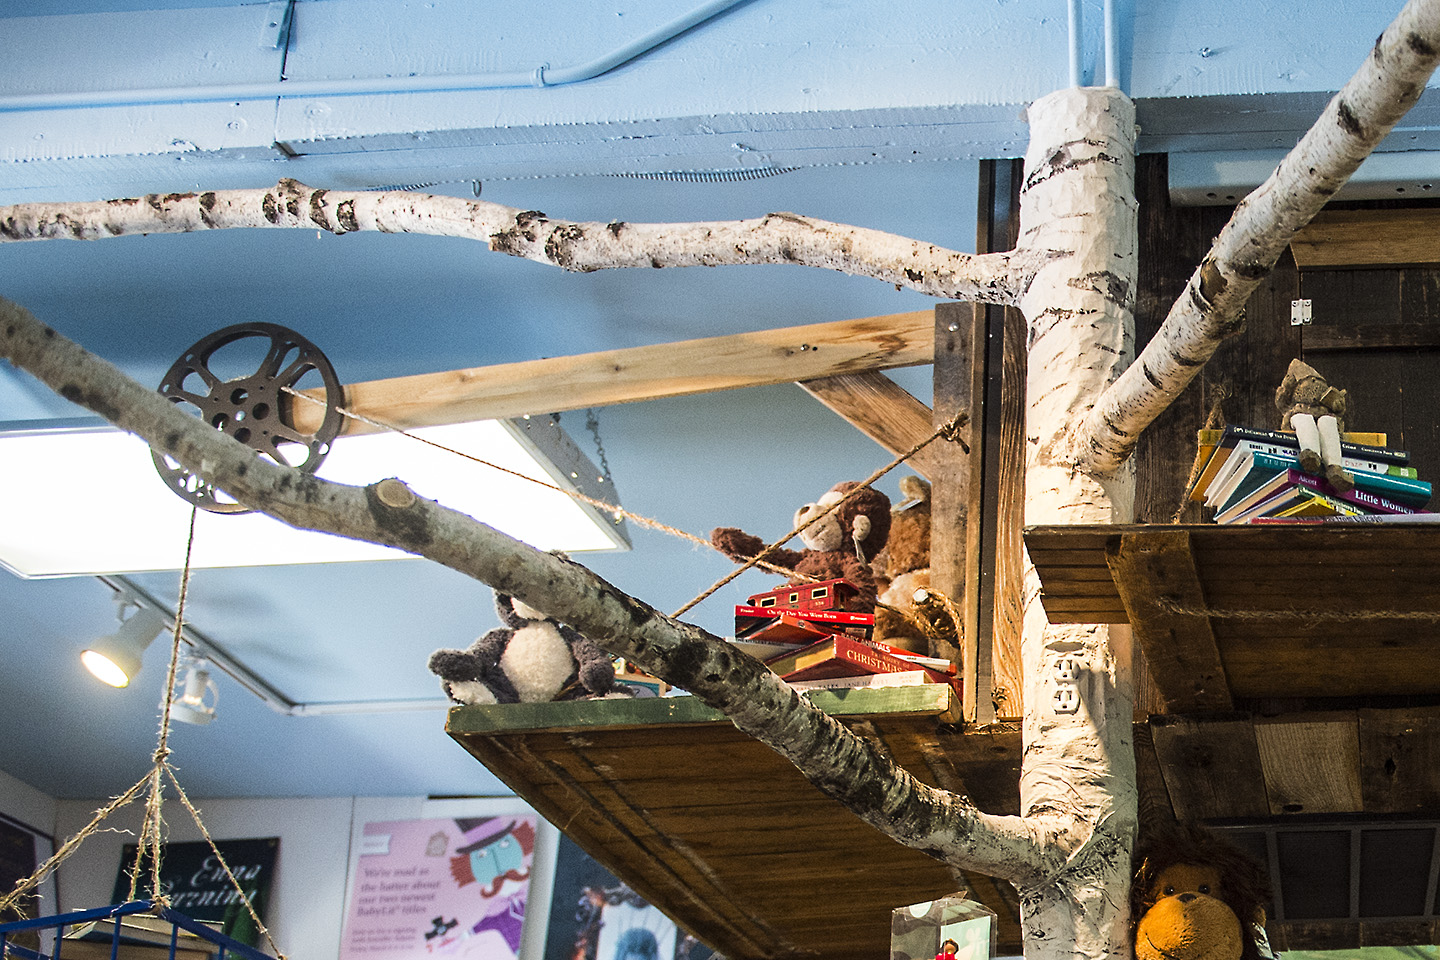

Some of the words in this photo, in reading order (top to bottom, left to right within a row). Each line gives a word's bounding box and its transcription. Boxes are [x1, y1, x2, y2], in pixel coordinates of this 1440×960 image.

[1299, 475, 1317, 486] Alcott
[1355, 489, 1379, 505] Little
[1381, 500, 1415, 514] Women
[847, 650, 902, 673] CHRISTMAS
